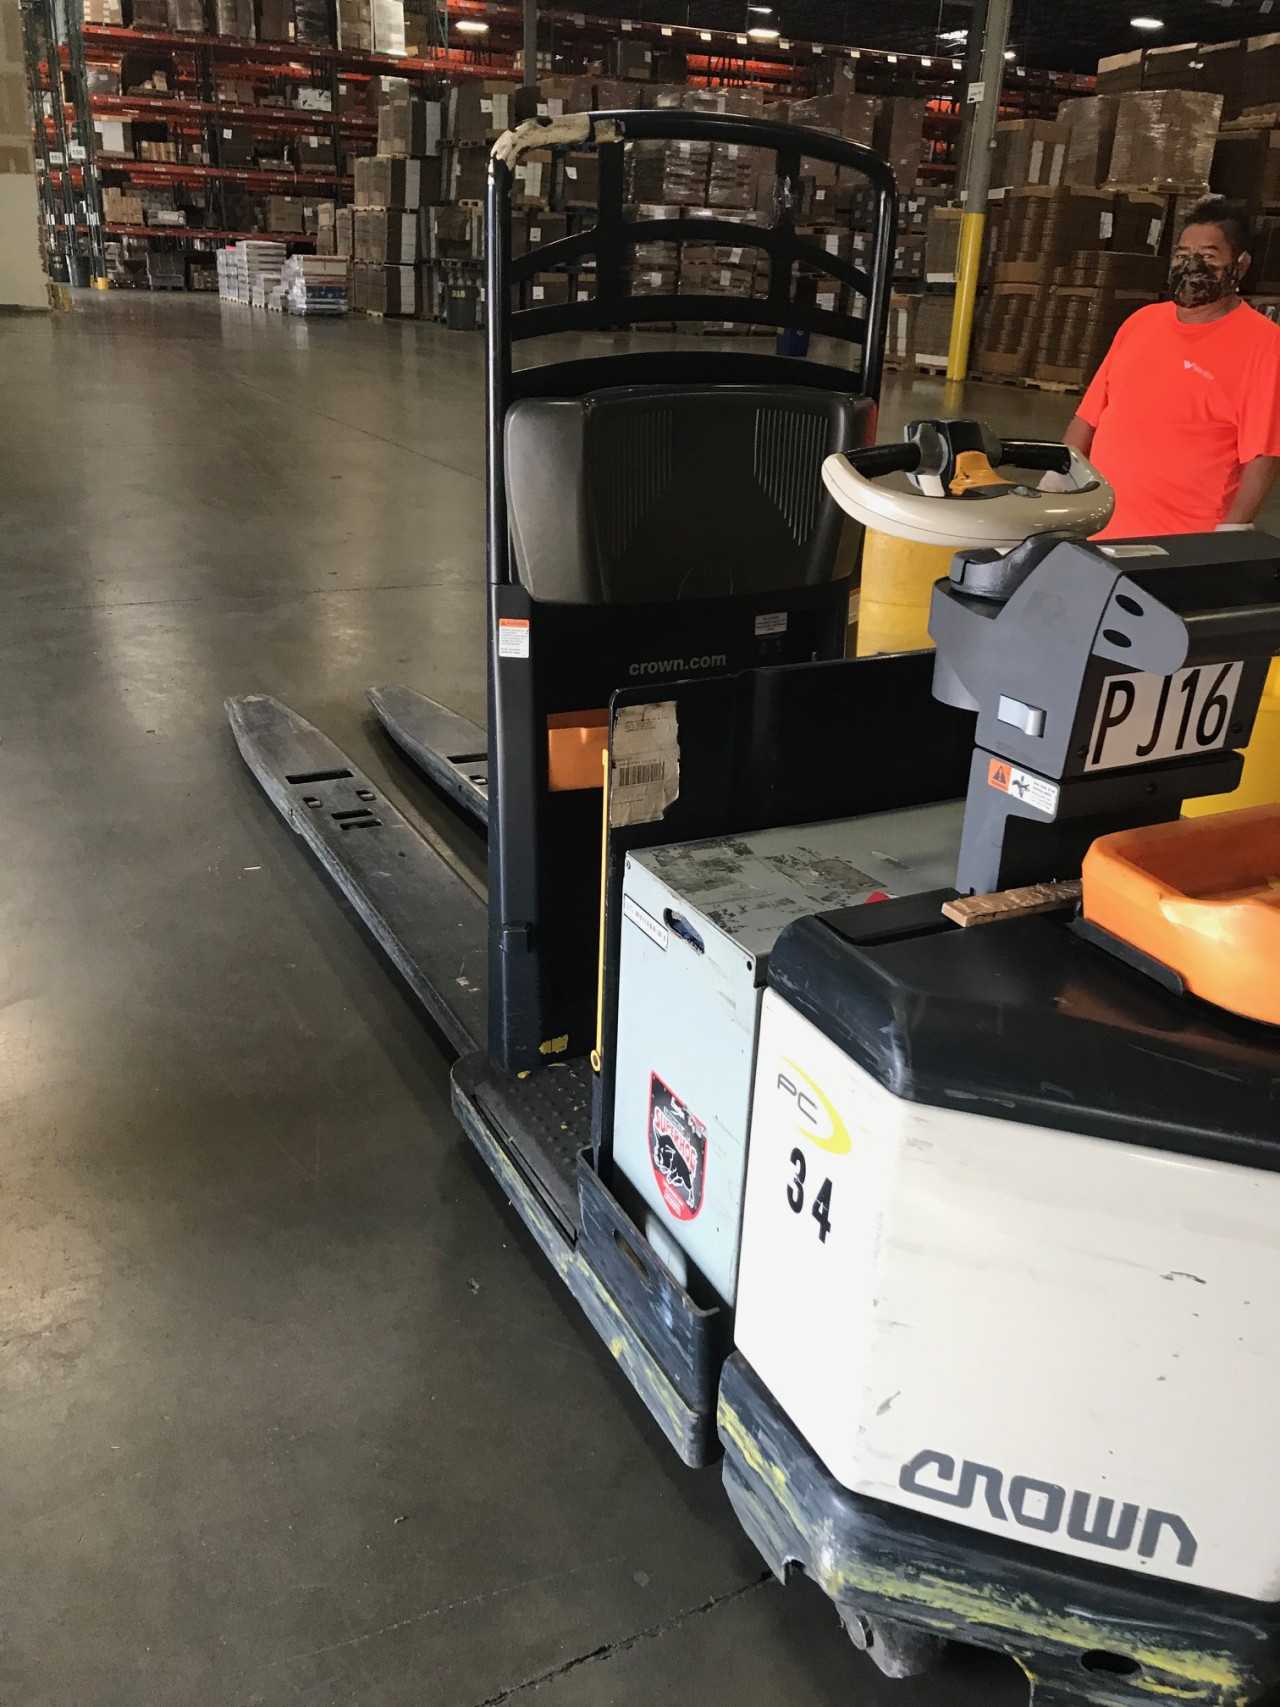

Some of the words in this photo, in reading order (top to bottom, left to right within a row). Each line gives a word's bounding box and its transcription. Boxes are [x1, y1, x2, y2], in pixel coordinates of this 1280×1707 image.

[628, 654, 727, 676] crown.com
[777, 1072, 818, 1125] PC
[786, 1147, 833, 1244] 34
[899, 1449, 1198, 1567] CROWN
